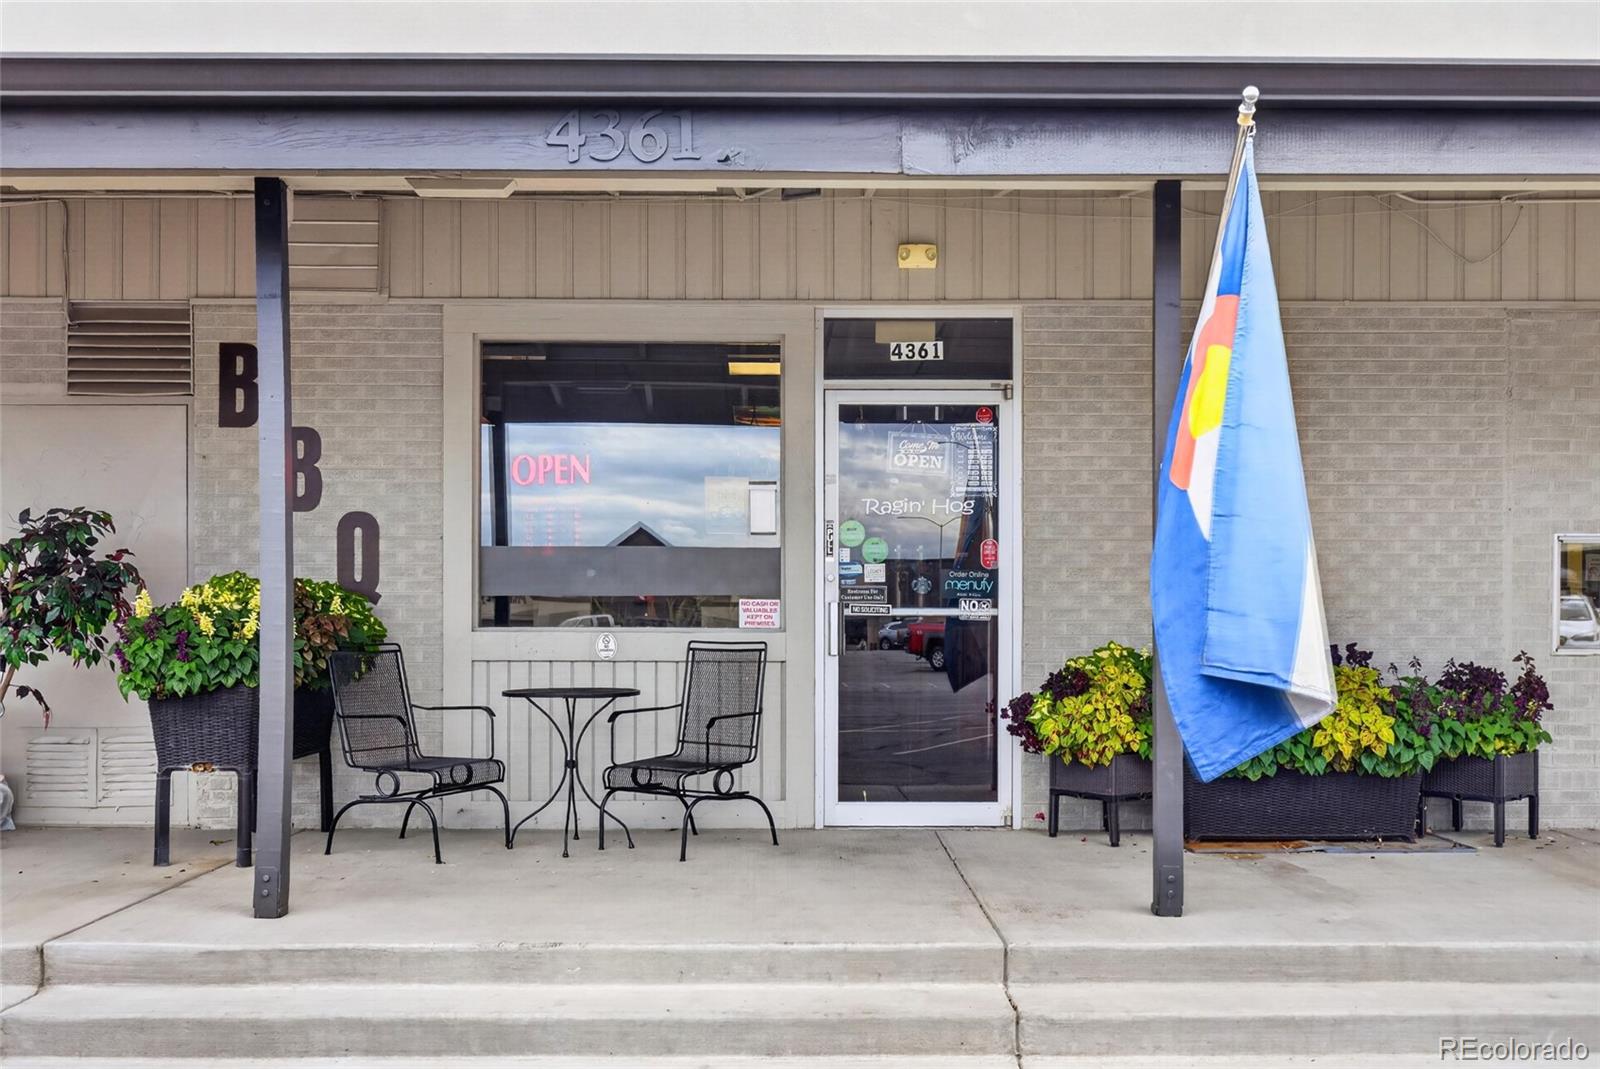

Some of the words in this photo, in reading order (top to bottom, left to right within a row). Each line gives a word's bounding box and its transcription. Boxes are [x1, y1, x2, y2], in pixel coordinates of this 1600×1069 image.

[545, 108, 702, 164] 4361
[891, 342, 941, 360] 4361
[899, 439, 927, 451] Come
[927, 440, 940, 451] In
[894, 453, 944, 469] OPEN
[511, 454, 591, 486] OPEN
[862, 498, 926, 516] Ragin'
[932, 499, 976, 516] Hog
[948, 570, 968, 578] Order
[968, 570, 990, 578] Online
[944, 577, 994, 593] menufy
[960, 600, 979, 611] NO
